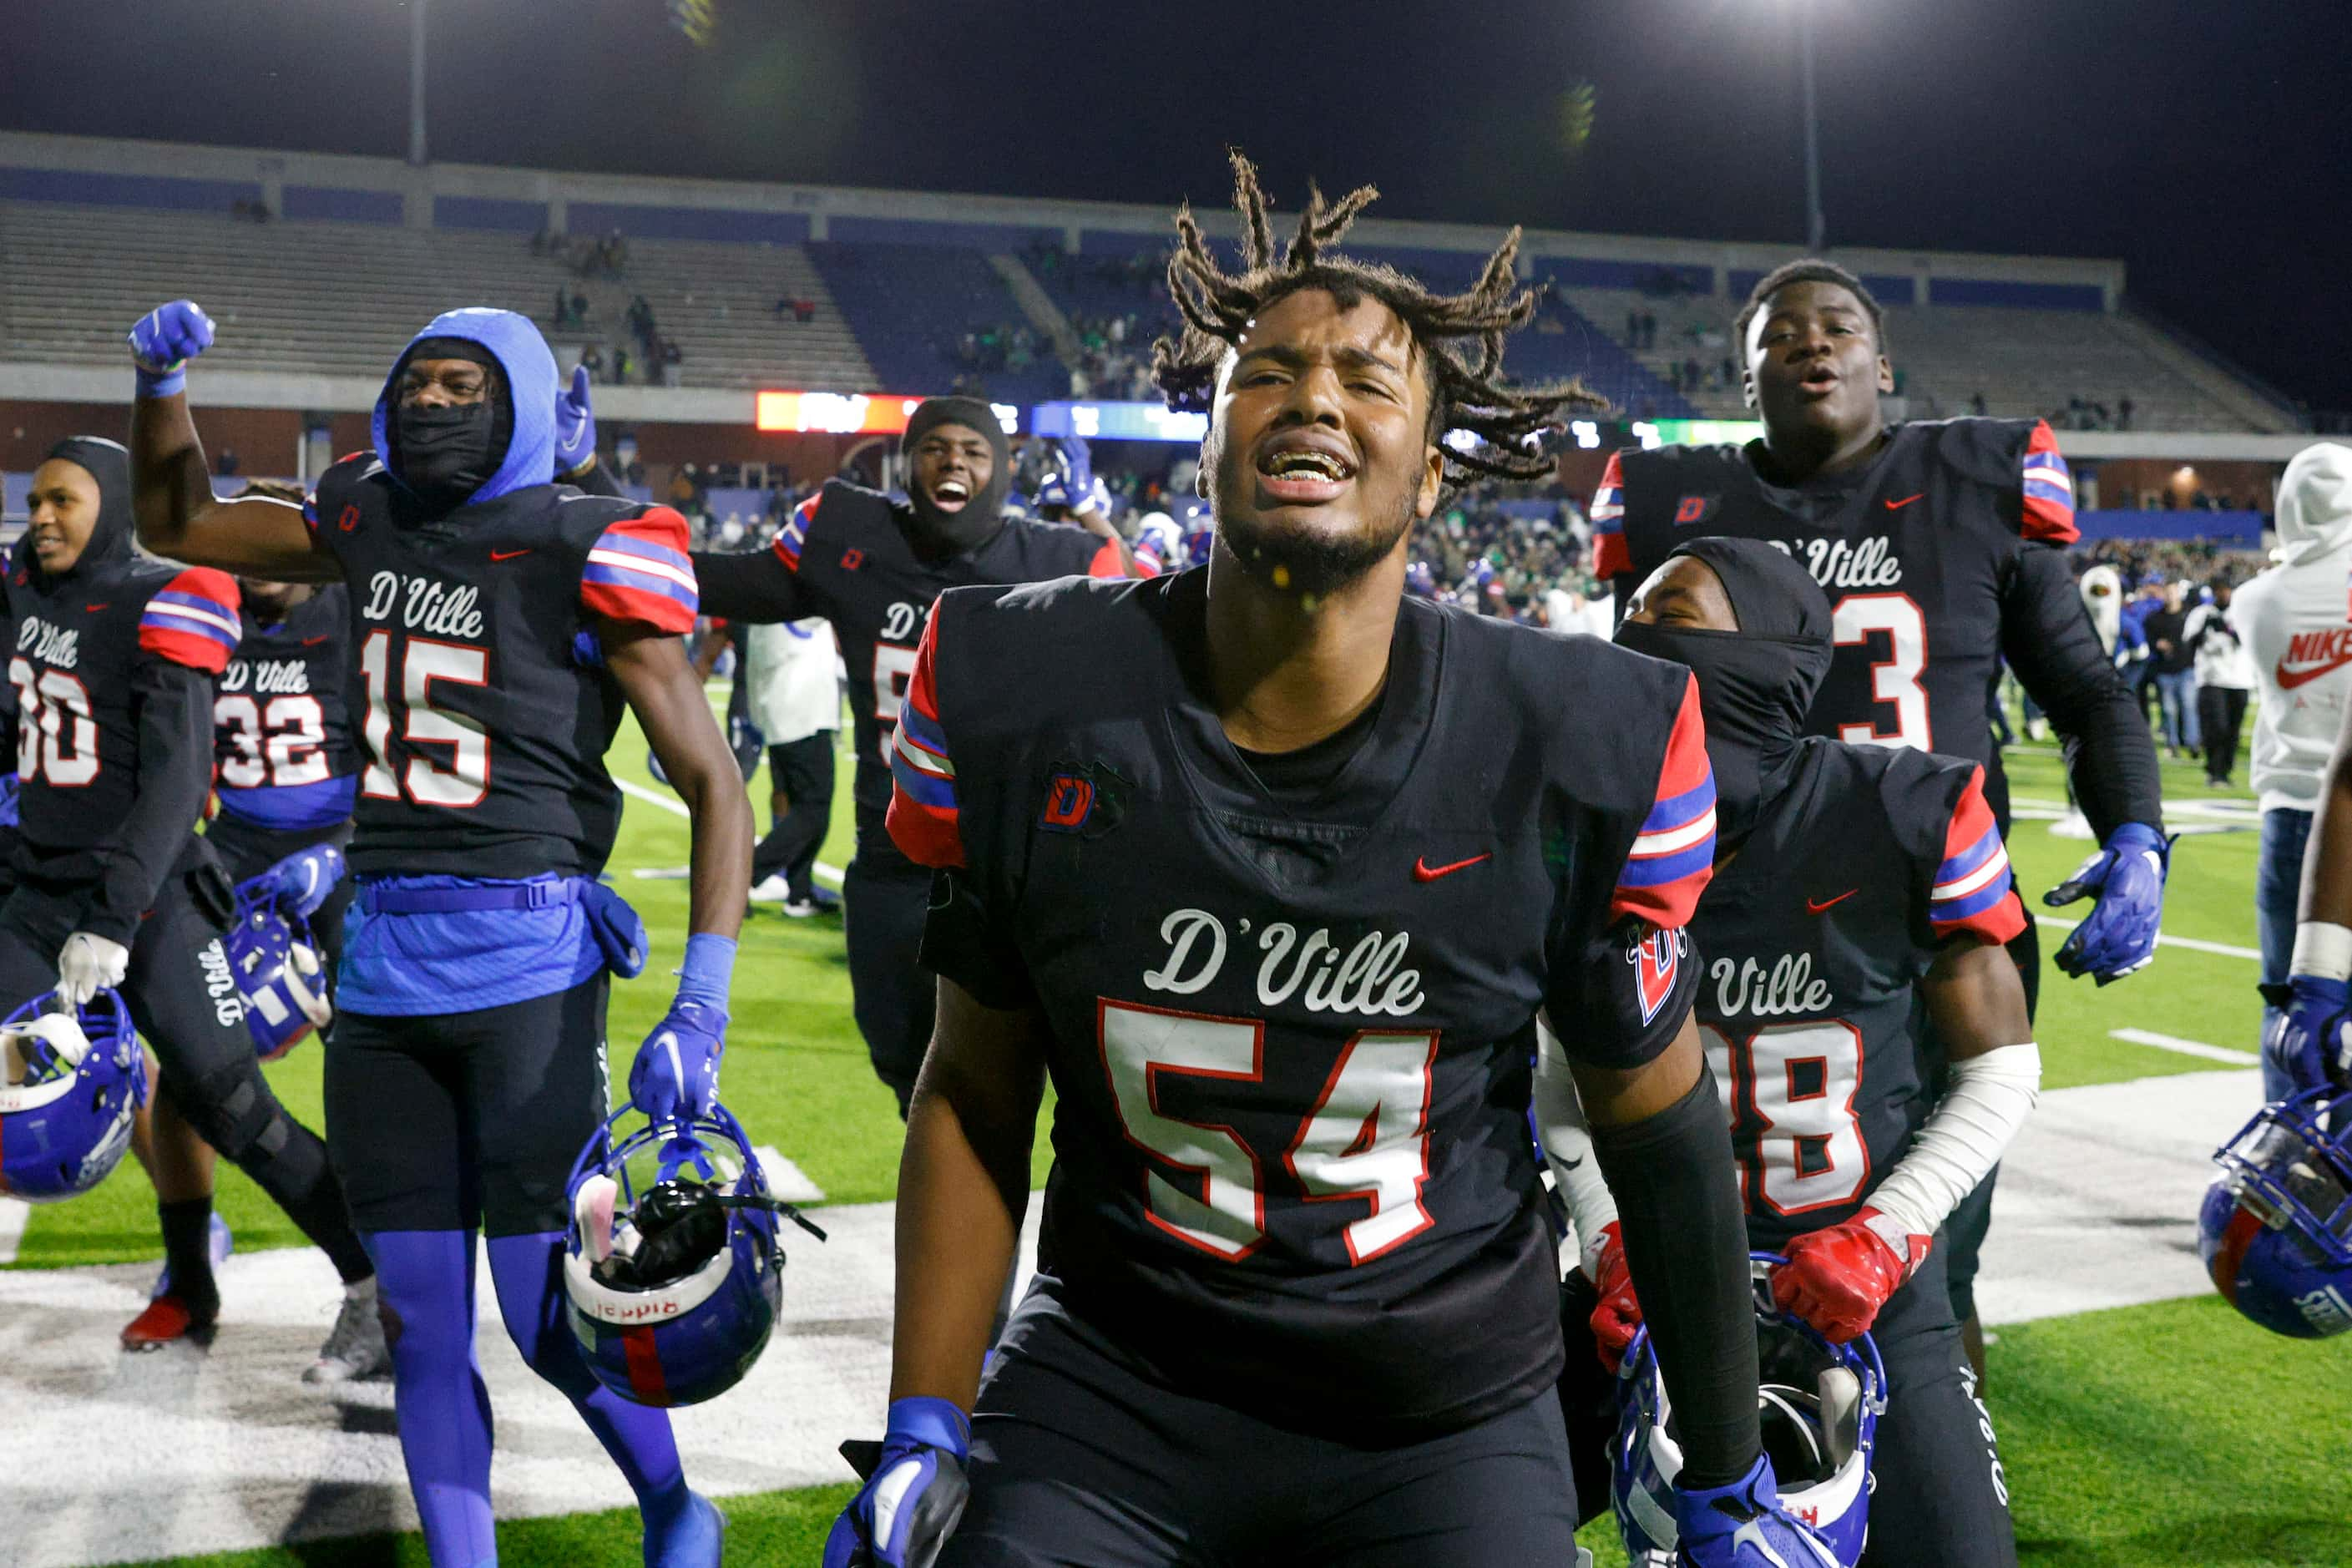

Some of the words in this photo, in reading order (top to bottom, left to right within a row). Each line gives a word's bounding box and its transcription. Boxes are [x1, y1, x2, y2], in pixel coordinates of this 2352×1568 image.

[1768, 536, 1903, 586] 'Ville
[363, 570, 484, 638] D'Ville
[17, 615, 79, 669] D'Ville
[220, 659, 310, 694] D'Ville
[214, 695, 331, 787] 32
[359, 627, 490, 807] 15
[1037, 771, 1096, 832] D
[1142, 908, 1426, 1016] D'Ville
[1096, 995, 1442, 1267] 54
